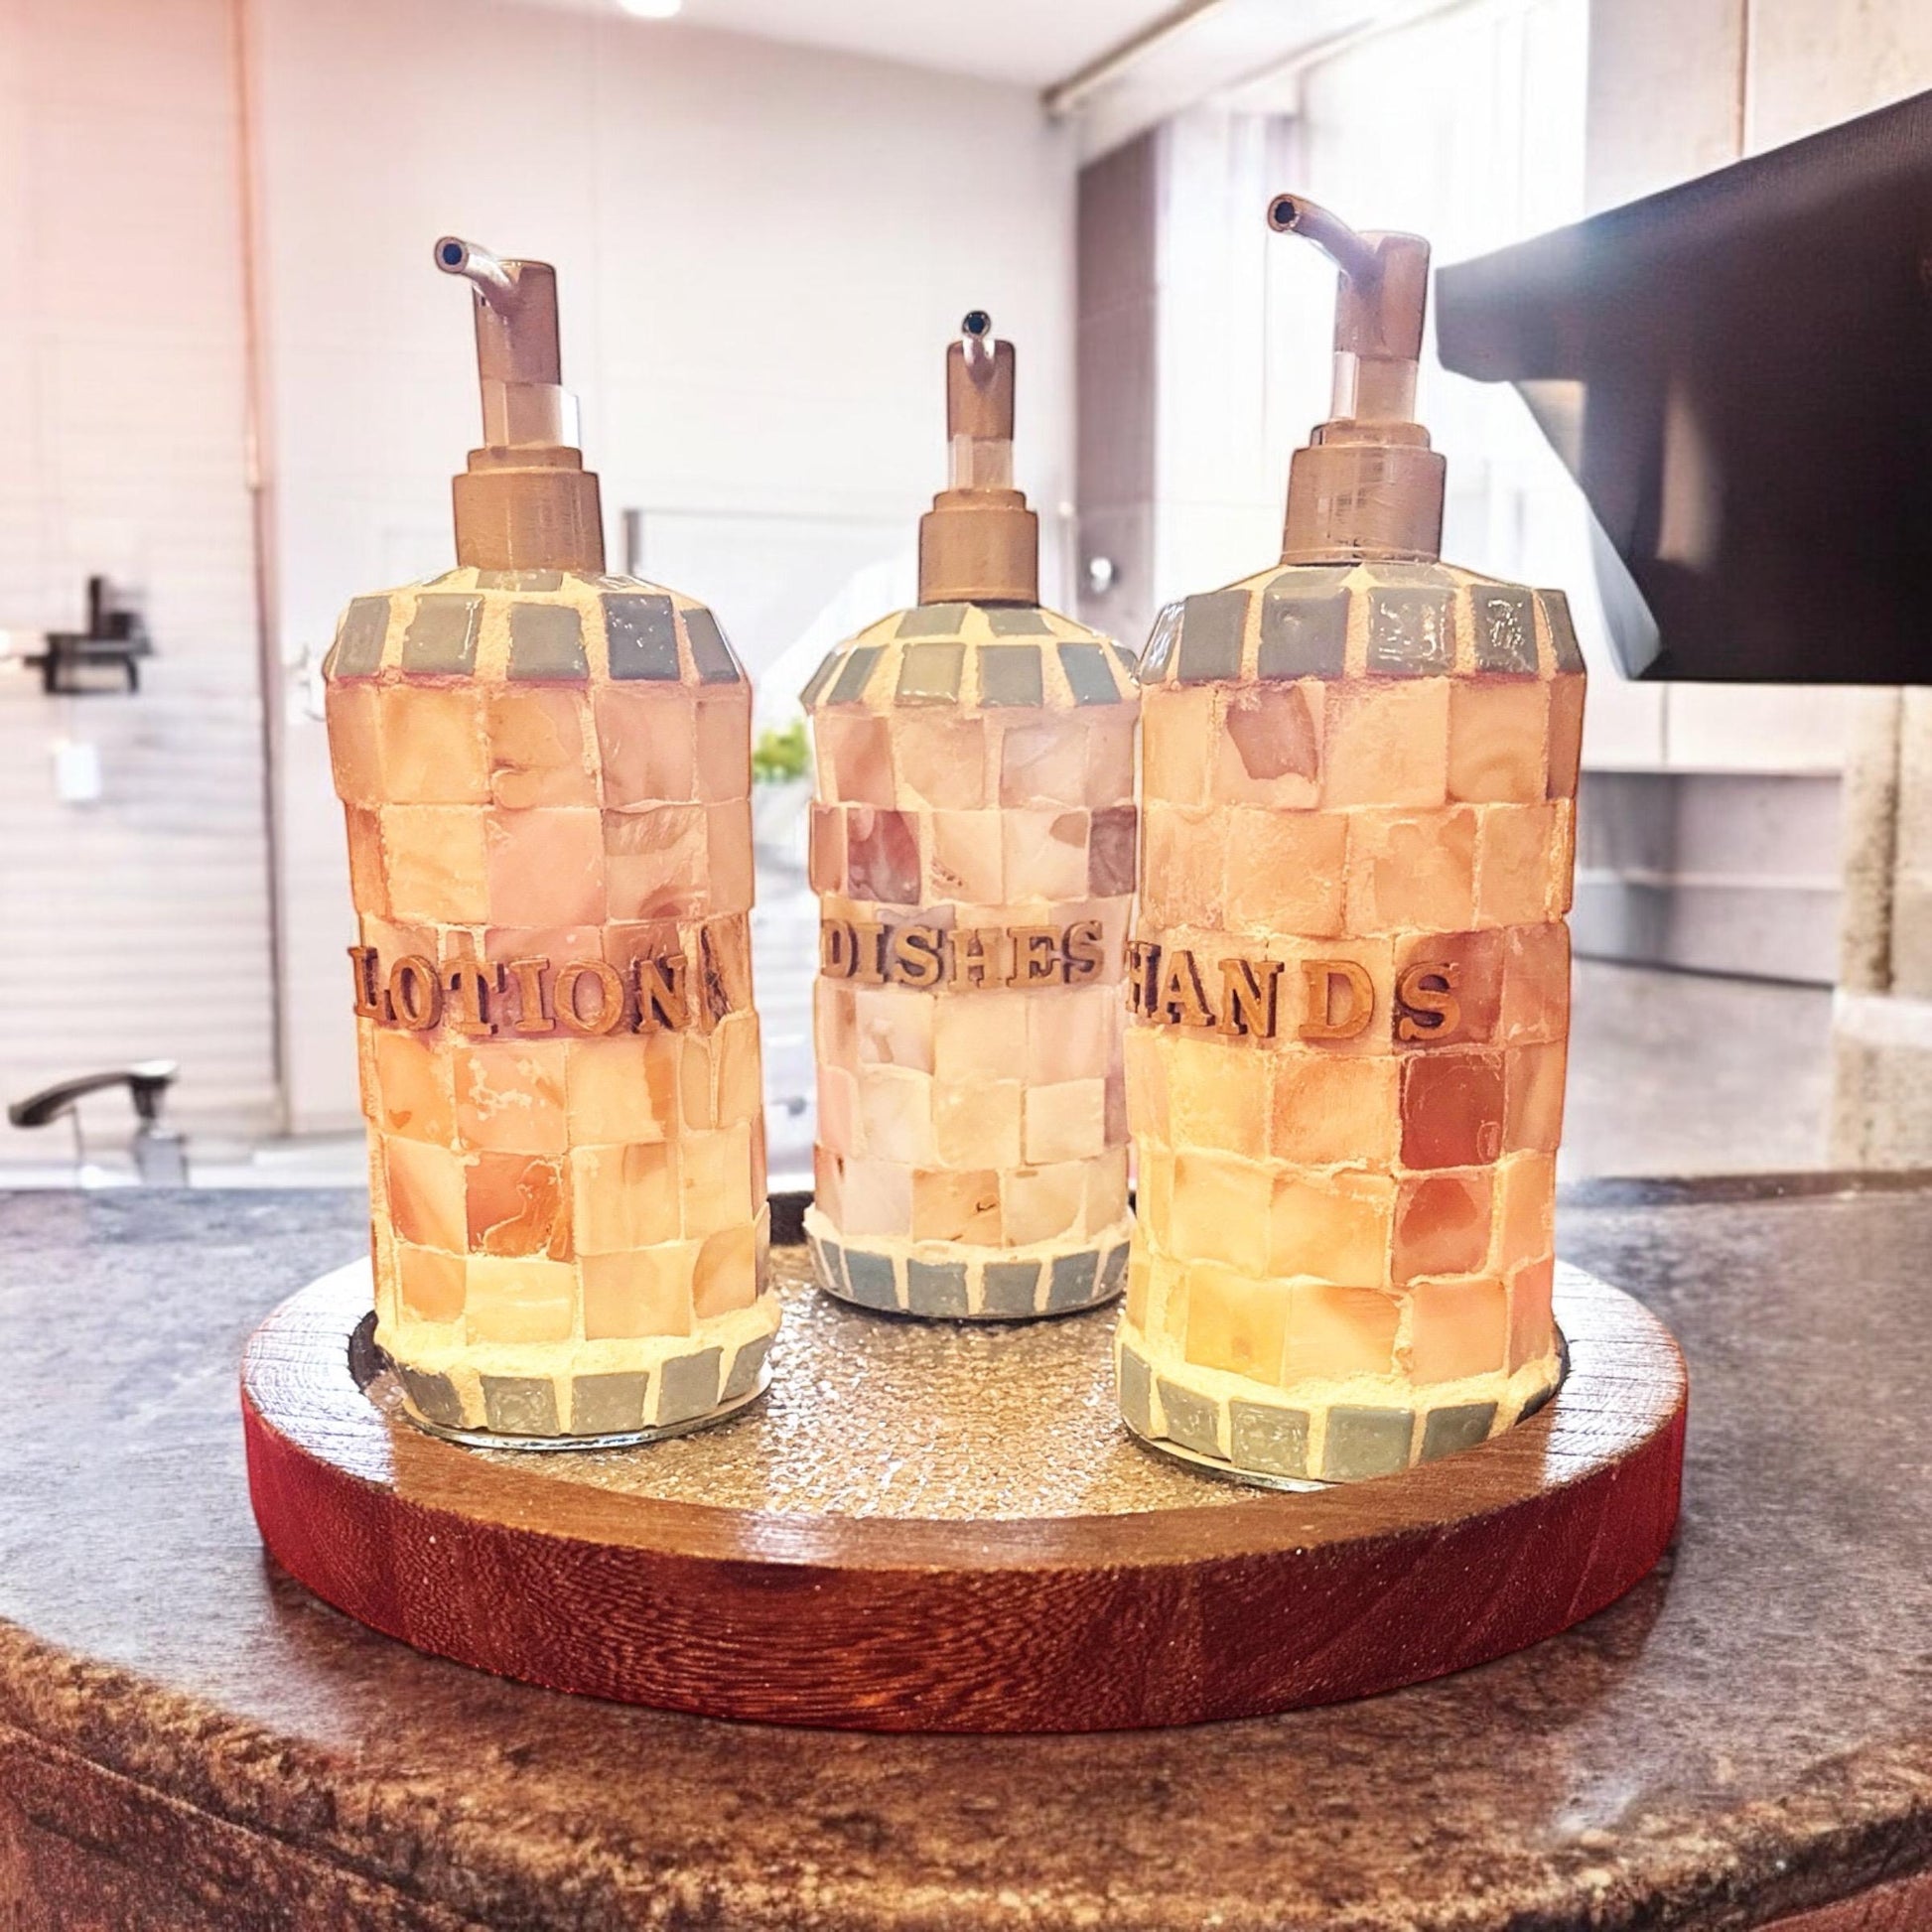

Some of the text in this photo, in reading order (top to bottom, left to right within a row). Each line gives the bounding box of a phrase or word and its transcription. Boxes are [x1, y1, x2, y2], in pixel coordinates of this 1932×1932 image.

[347, 945, 692, 1035] LOTION
[821, 919, 1104, 989] DISHES
[1125, 940, 1460, 1041] HANDS
